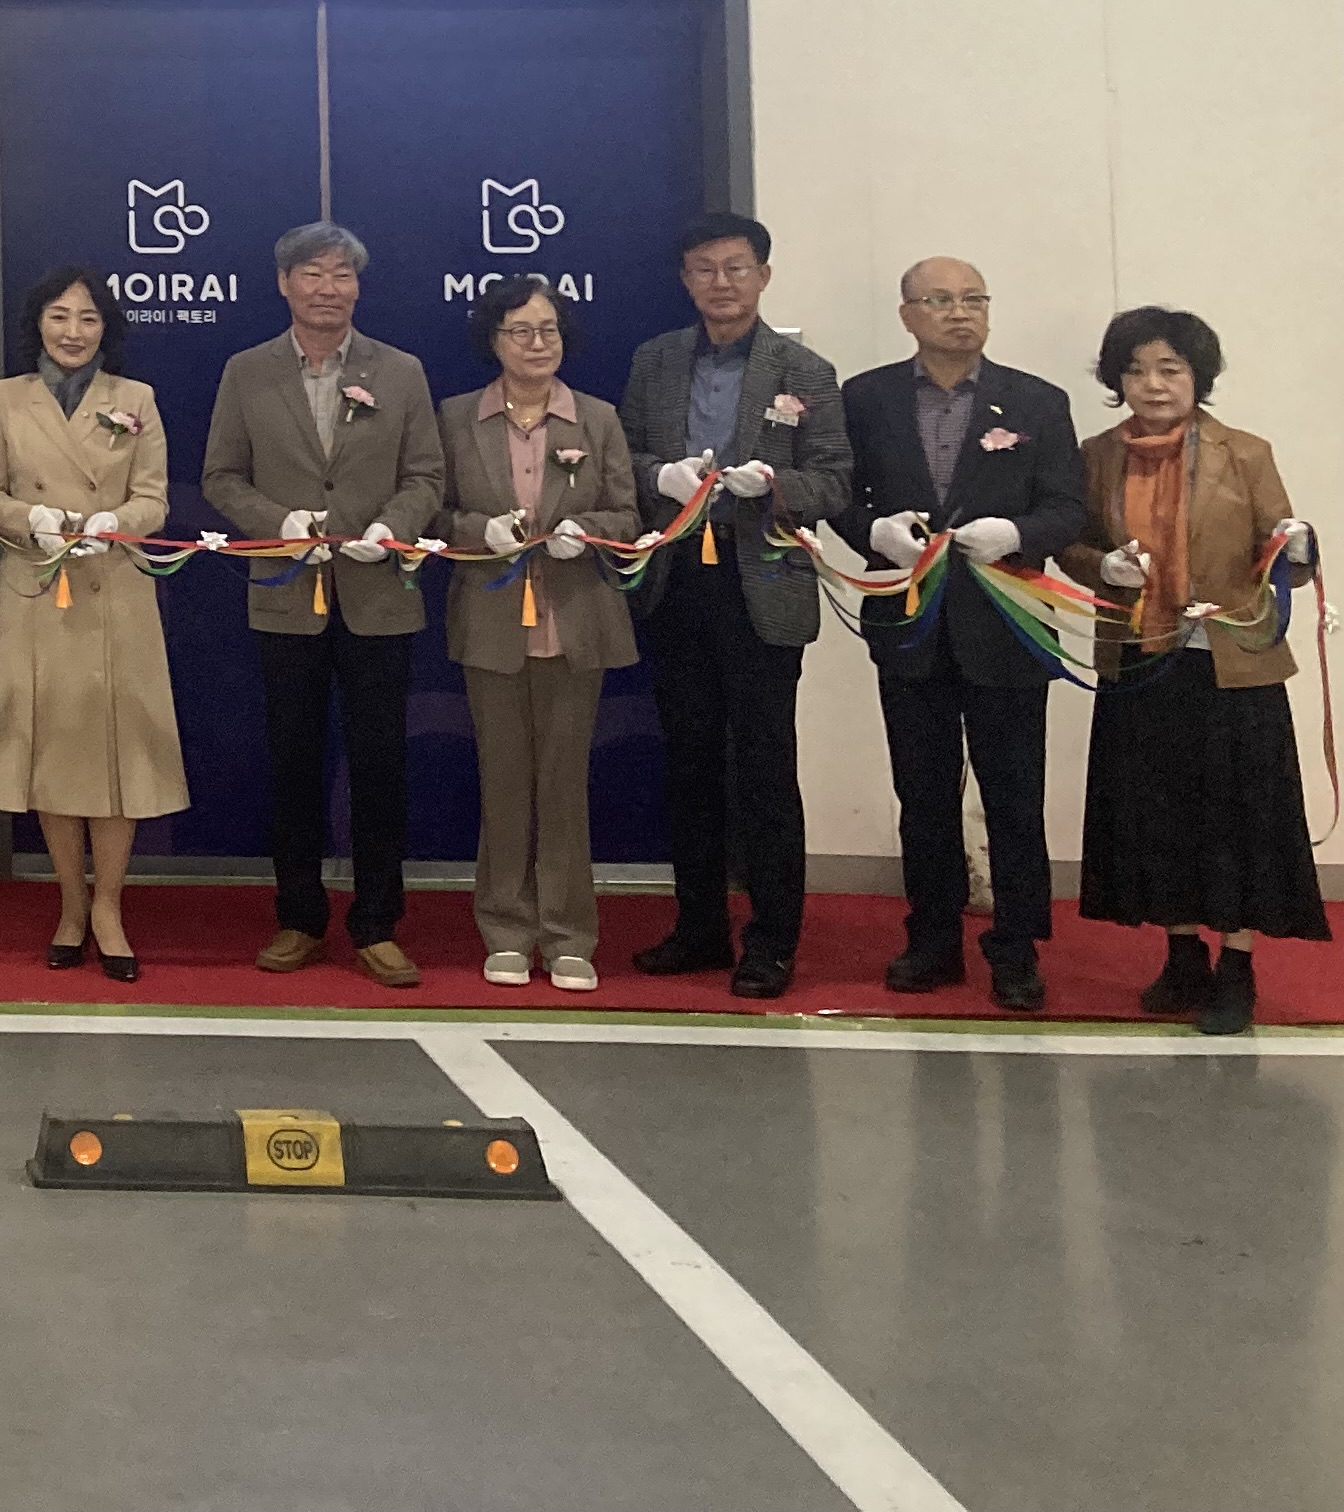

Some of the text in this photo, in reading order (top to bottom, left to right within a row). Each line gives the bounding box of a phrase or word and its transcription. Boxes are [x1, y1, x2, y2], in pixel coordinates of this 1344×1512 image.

[125, 309, 217, 324] 이라이 팩토리
[273, 1139, 313, 1160] STOP
